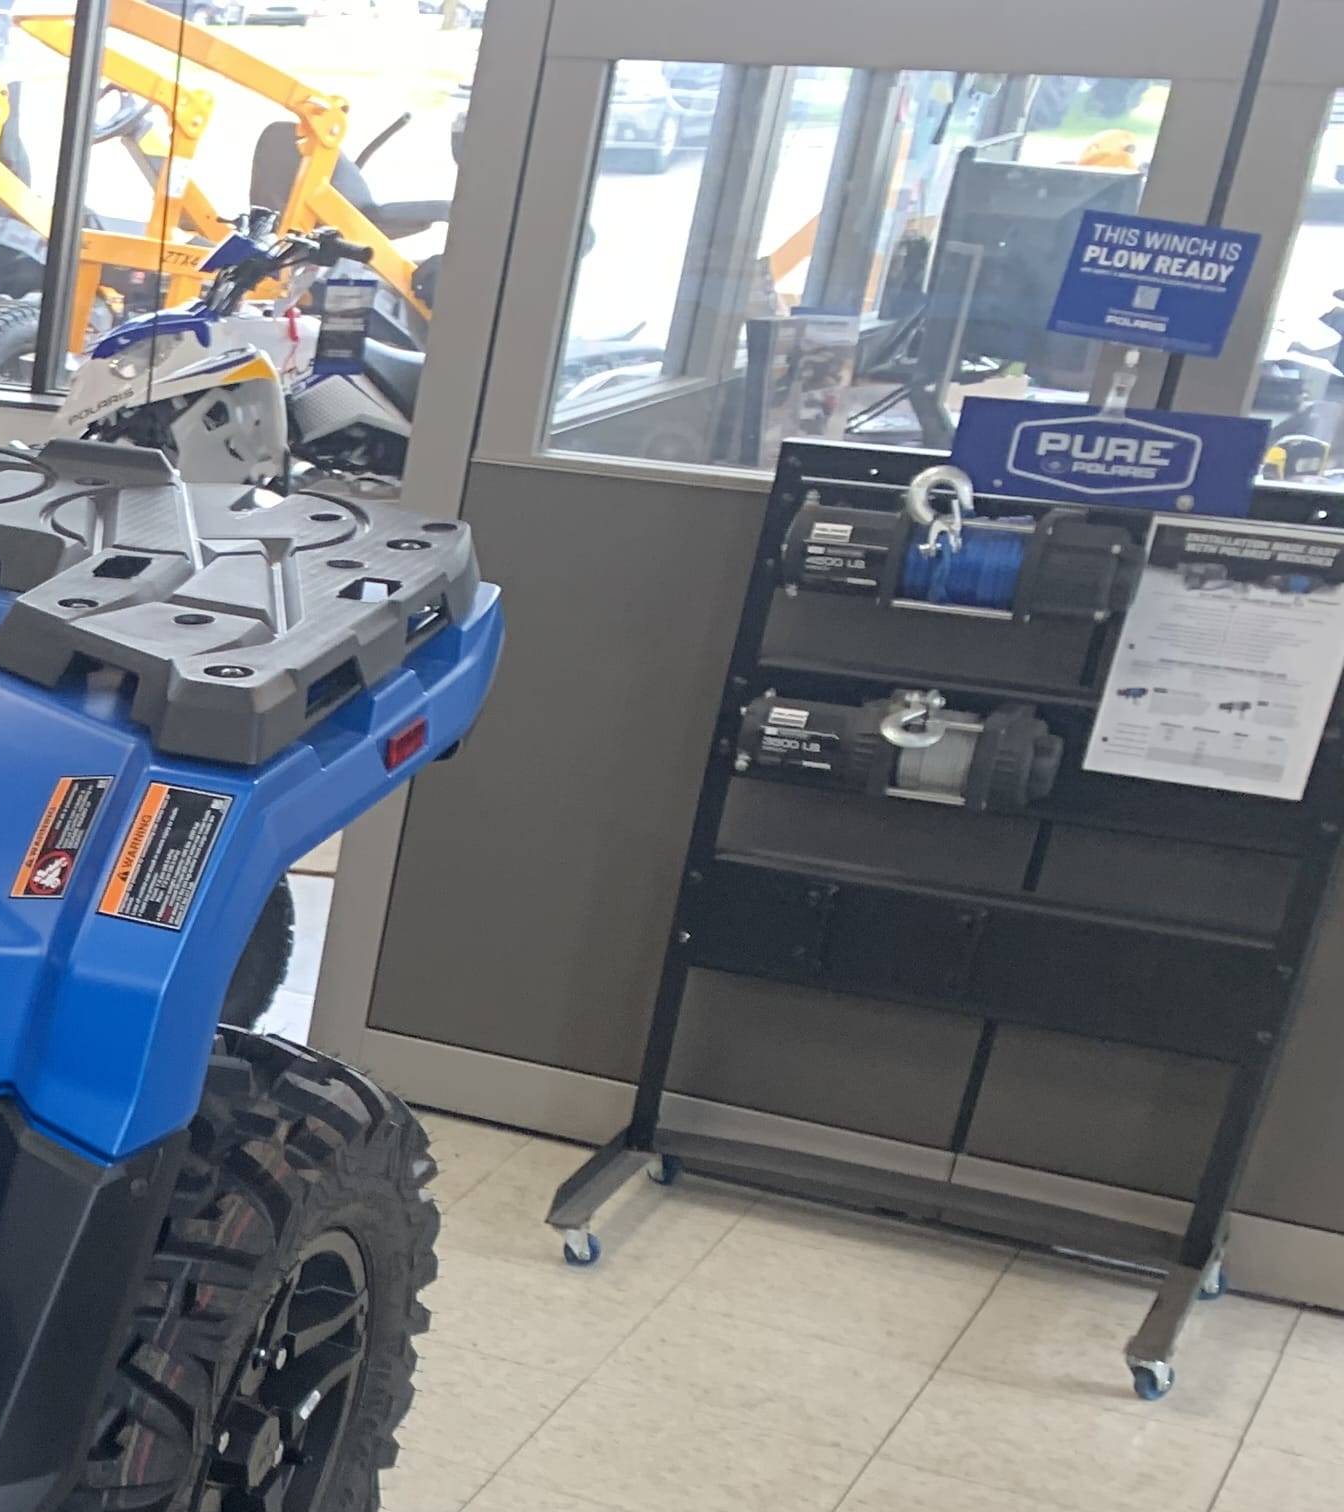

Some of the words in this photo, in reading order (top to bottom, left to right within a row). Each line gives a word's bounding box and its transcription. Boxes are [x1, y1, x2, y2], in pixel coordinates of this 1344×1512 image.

[1093, 224, 1141, 247] THIS
[1144, 231, 1217, 258] WINCH
[1218, 241, 1243, 261] IS
[1083, 245, 1152, 271] PLOW
[1153, 254, 1235, 284] READY
[68, 387, 135, 426] POLARIS
[1036, 431, 1175, 467] PURE
[1072, 461, 1160, 479] POLARIS
[121, 814, 152, 869] WARNING
